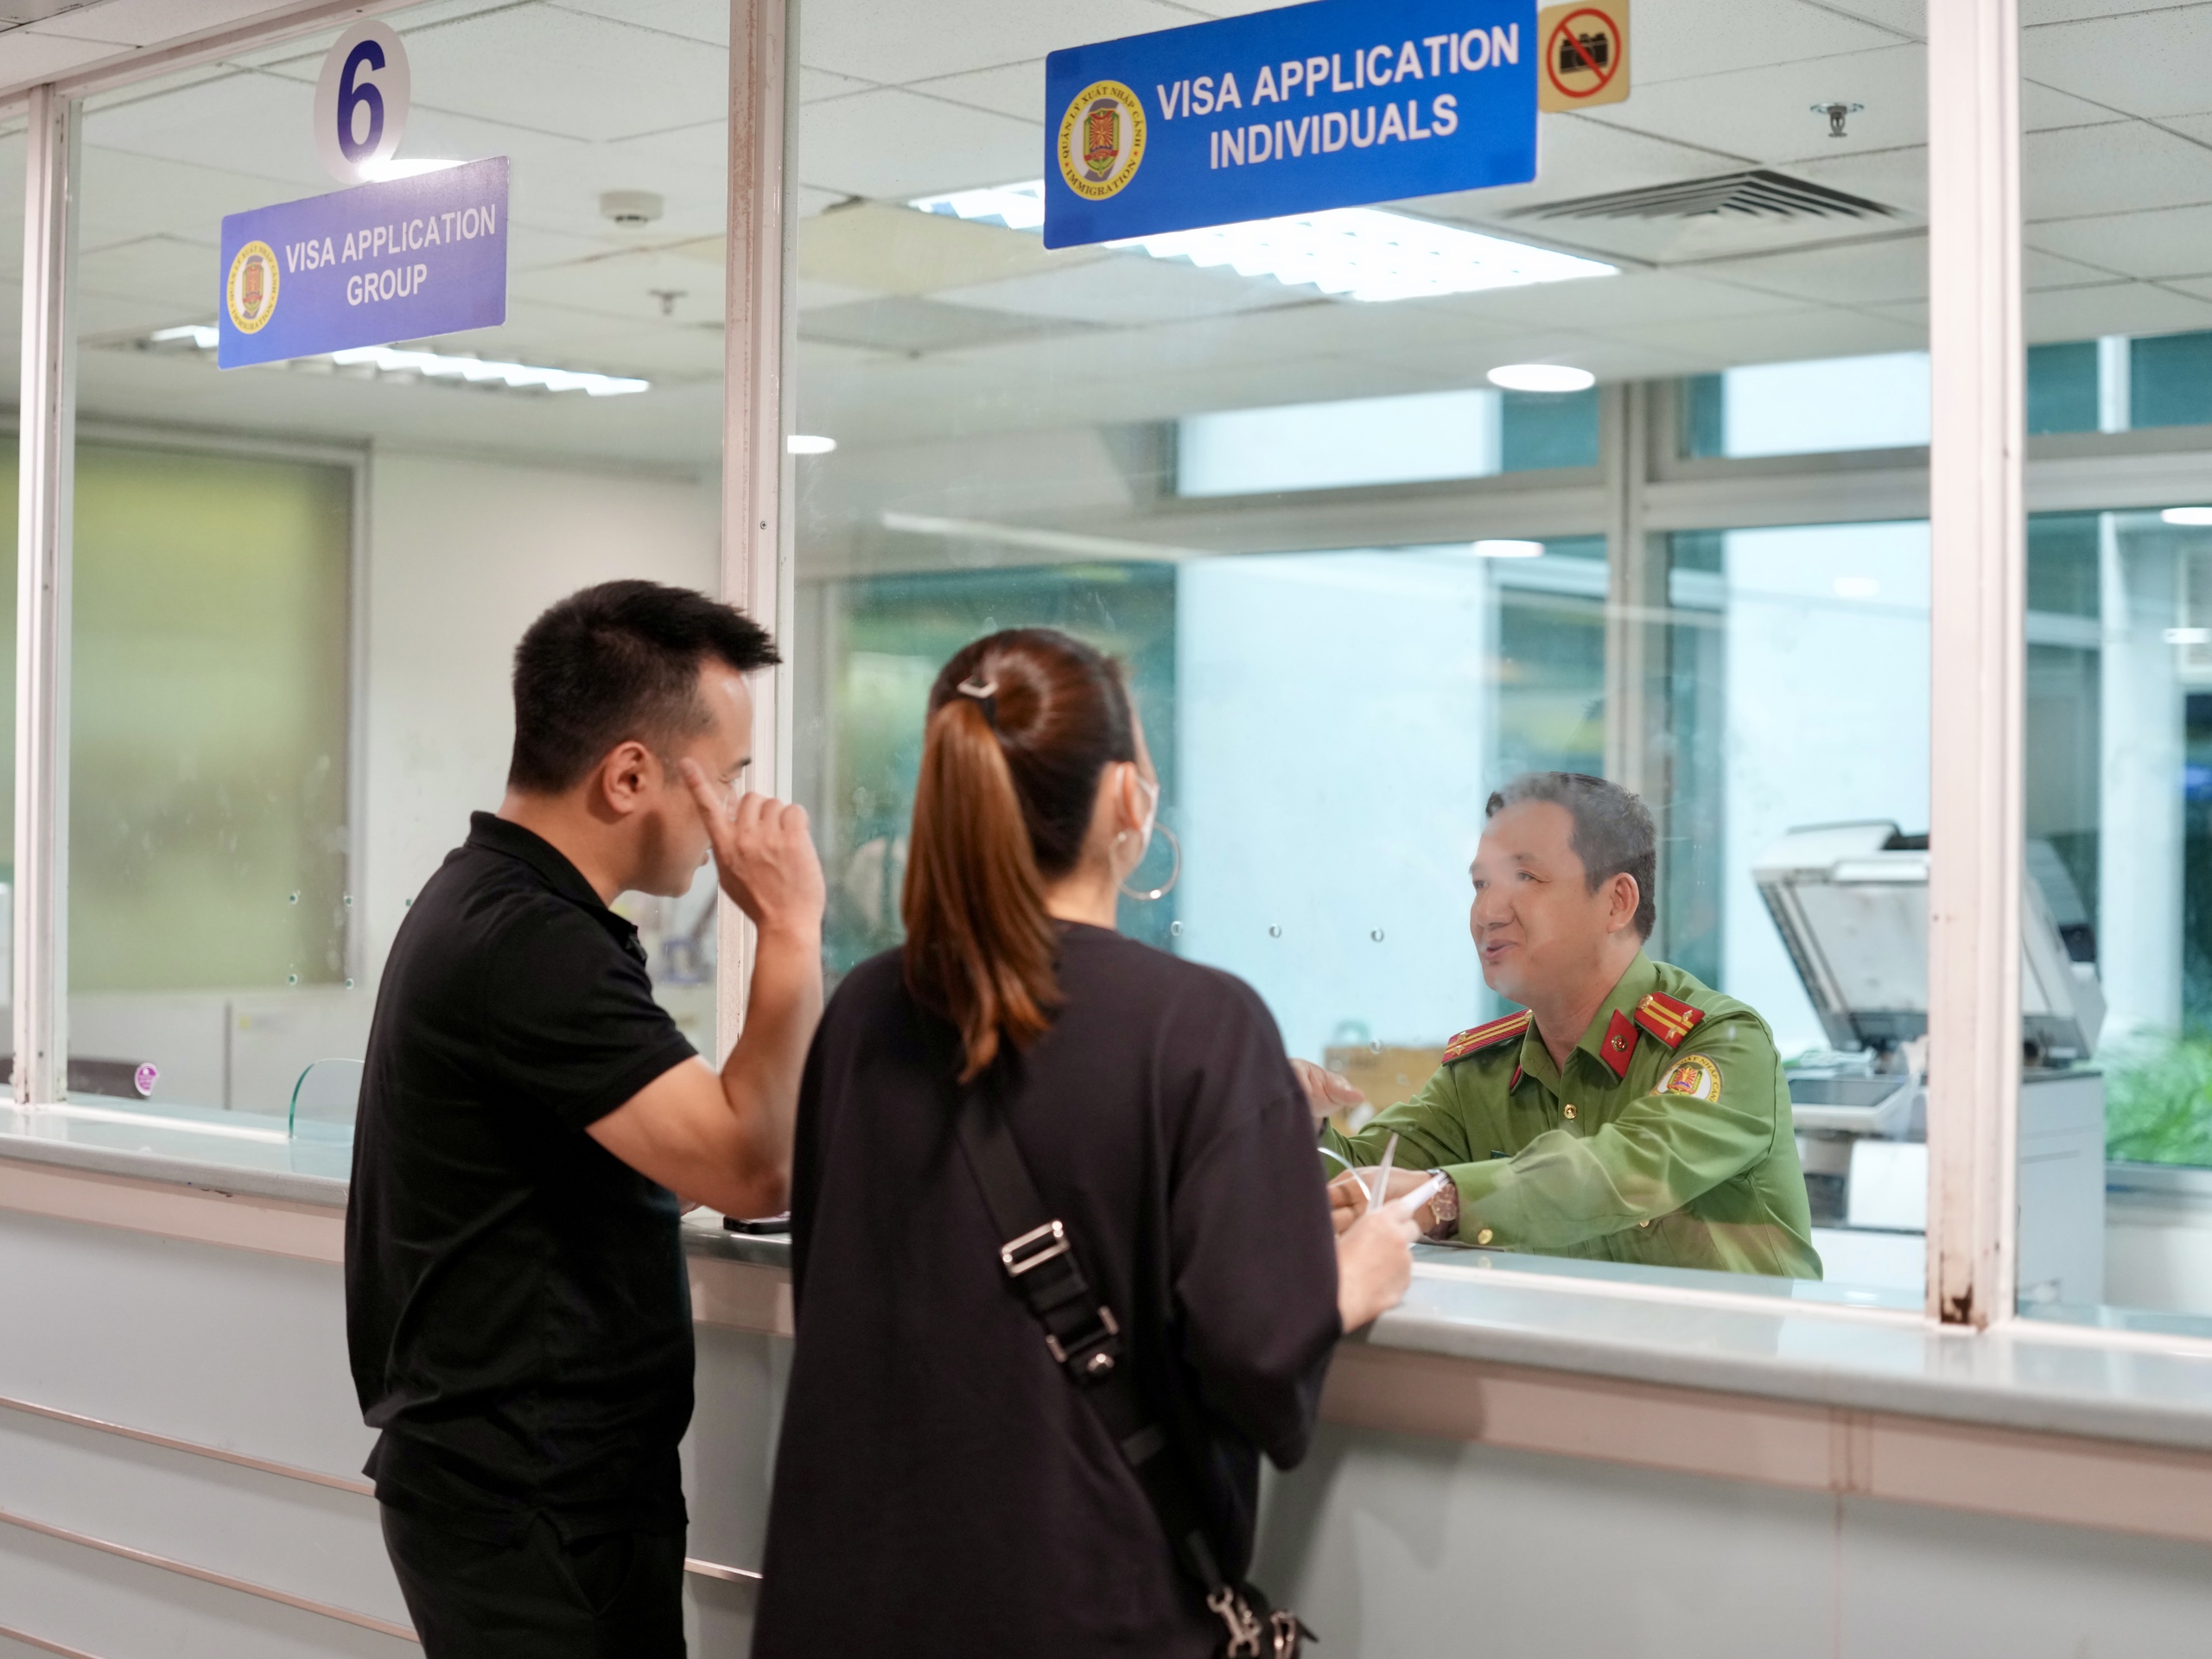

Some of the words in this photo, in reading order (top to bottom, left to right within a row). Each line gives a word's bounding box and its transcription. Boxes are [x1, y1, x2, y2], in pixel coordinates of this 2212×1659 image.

[337, 39, 385, 164] 6
[1156, 72, 1243, 121] VISA
[1250, 22, 1519, 106] APPLICATION
[1211, 93, 1459, 170] INDIVIDUALS
[1065, 159, 1137, 196] IMMIGRATION
[285, 236, 336, 274] VISA
[341, 204, 496, 264] APPLICATION
[231, 304, 274, 332] IMMIGRATION
[346, 263, 428, 307] GROUP
